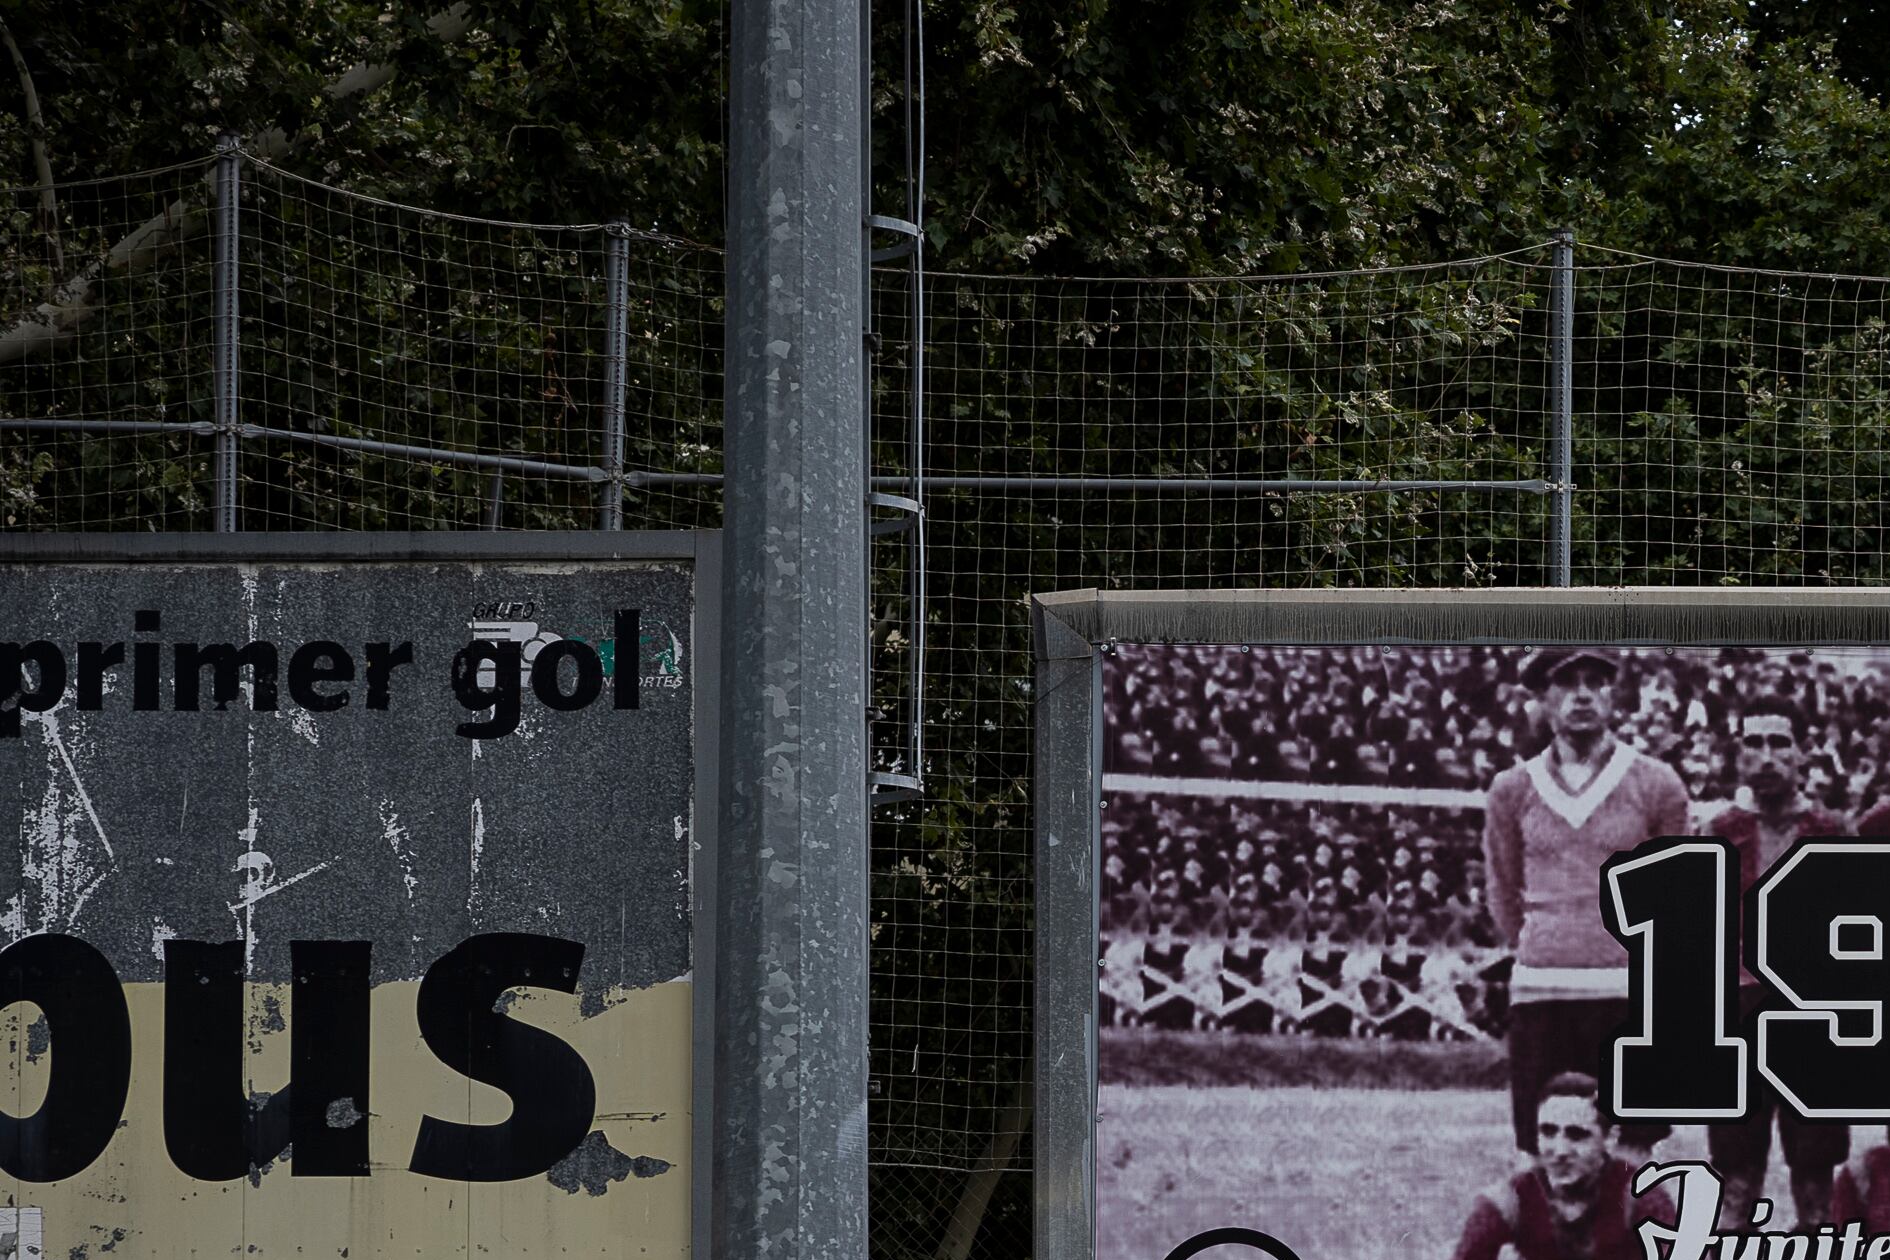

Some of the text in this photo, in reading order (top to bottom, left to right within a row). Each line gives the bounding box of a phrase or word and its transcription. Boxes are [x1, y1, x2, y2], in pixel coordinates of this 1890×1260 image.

[472, 601, 535, 619] GRUPO
[0, 609, 641, 740] primer gol
